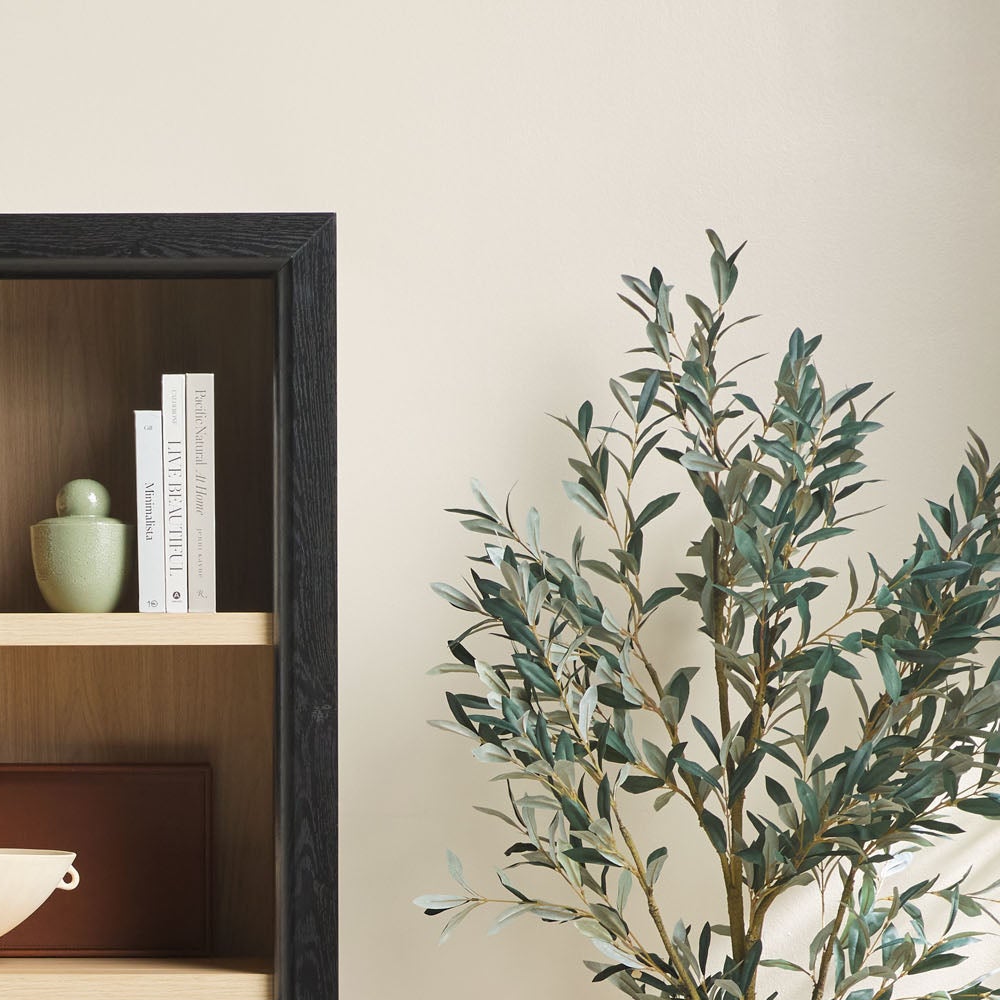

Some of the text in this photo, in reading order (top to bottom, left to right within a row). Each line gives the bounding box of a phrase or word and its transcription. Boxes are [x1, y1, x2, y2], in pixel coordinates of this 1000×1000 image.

[145, 482, 156, 541] Minimalista
[168, 440, 184, 577] LIVE BEAUTIFUL
[195, 389, 208, 516] Pacific Natural At Home
